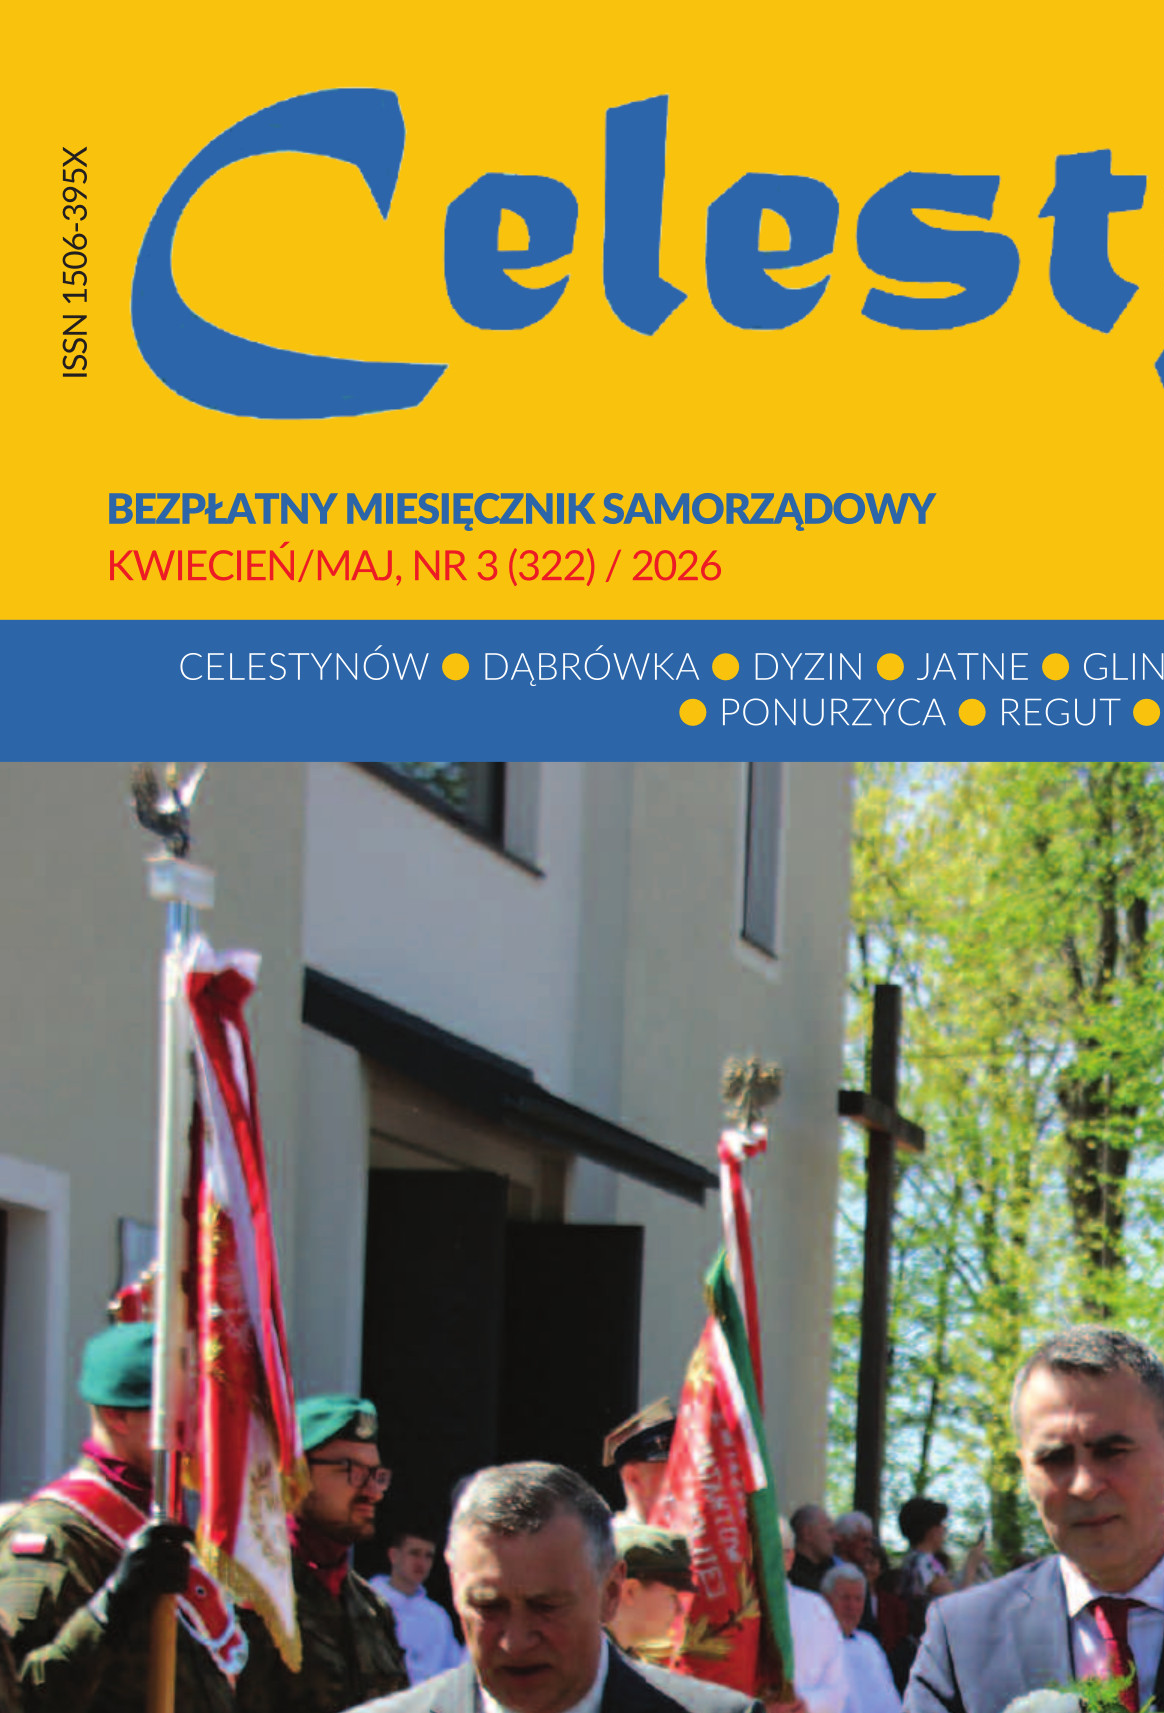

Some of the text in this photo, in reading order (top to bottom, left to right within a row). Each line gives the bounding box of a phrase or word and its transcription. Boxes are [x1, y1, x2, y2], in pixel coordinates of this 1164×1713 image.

[61, 146, 88, 378] ISSN 1506-395X
[108, 492, 937, 532] BEZPŁATNY MIESIĘCZNIK SAMORZĄDOWY
[109, 540, 722, 587] KWIECIEŃ/MAJ, NR 3 (322) / 2026
[179, 644, 430, 681] CELESTYNÓW
[484, 644, 700, 689] DĄBRÓWKA
[754, 652, 862, 681] DYZIN
[916, 652, 1029, 681] JATNE
[722, 697, 947, 727] PONURZYCA
[1001, 697, 1122, 727] REGUT
